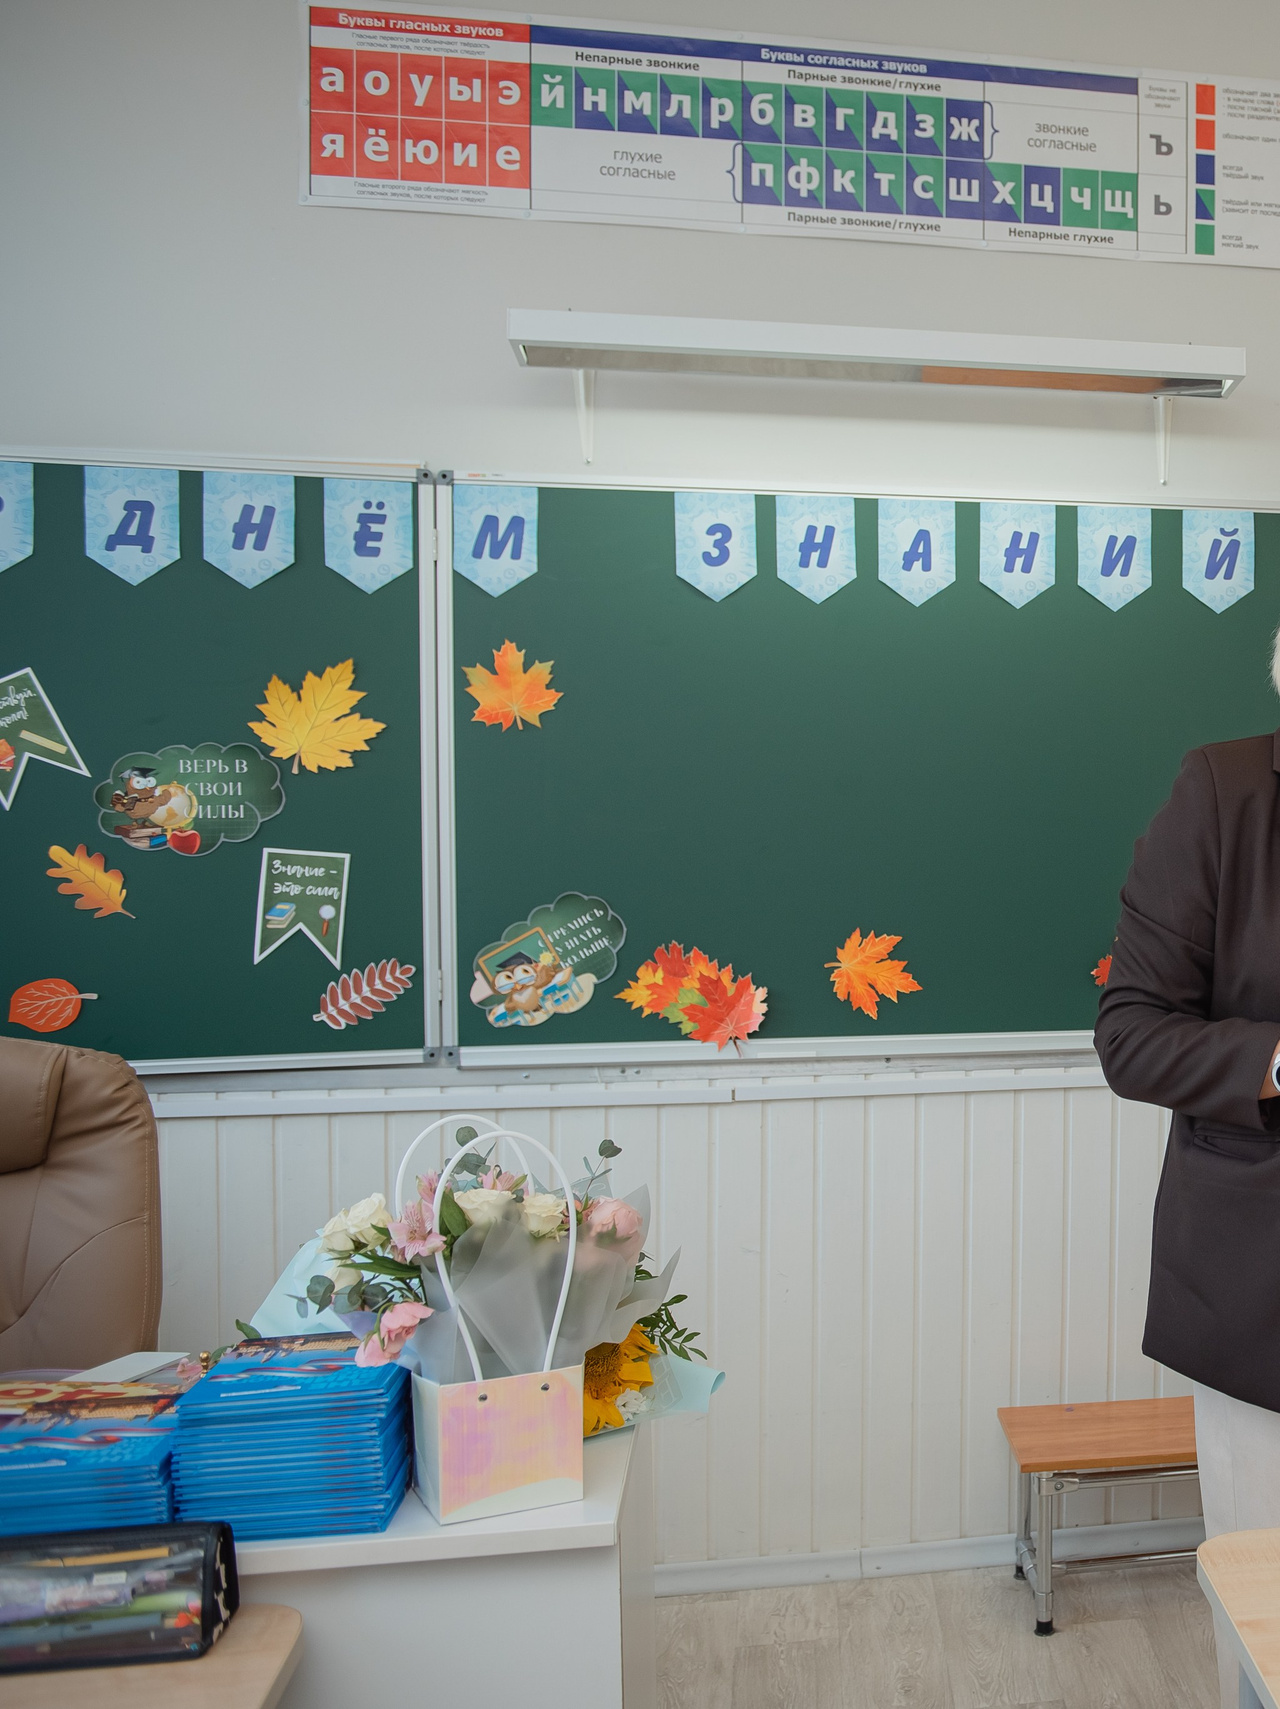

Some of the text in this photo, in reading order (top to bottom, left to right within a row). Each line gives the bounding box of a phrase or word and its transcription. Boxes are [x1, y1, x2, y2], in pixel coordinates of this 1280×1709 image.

[338, 12, 504, 38] Буквы гласных звуков
[575, 51, 700, 71] Непарные звонкие
[760, 48, 927, 75] Буквы согласных звуков
[320, 66, 521, 107] а о у ы э
[787, 69, 941, 92] Парные звонкие/глухие
[541, 74, 980, 142] й н м л р б в г д з ж
[1034, 122, 1089, 137] звонкие
[320, 128, 521, 171] я ё ю и е
[1027, 137, 1097, 152] согласные
[613, 150, 662, 164] глухие
[599, 165, 676, 180] согласные
[751, 158, 1134, 219] п ф к т с ш х ц ч щ
[787, 211, 941, 233] Парные звонкие/глухие
[1008, 227, 1114, 244] Непарные глухие
[179, 759, 248, 773] ВЕРЬ В
[185, 782, 242, 796] СВОИ
[184, 804, 244, 819] СИЛЫ
[271, 859, 326, 878] Знание
[273, 881, 340, 900] это сила
